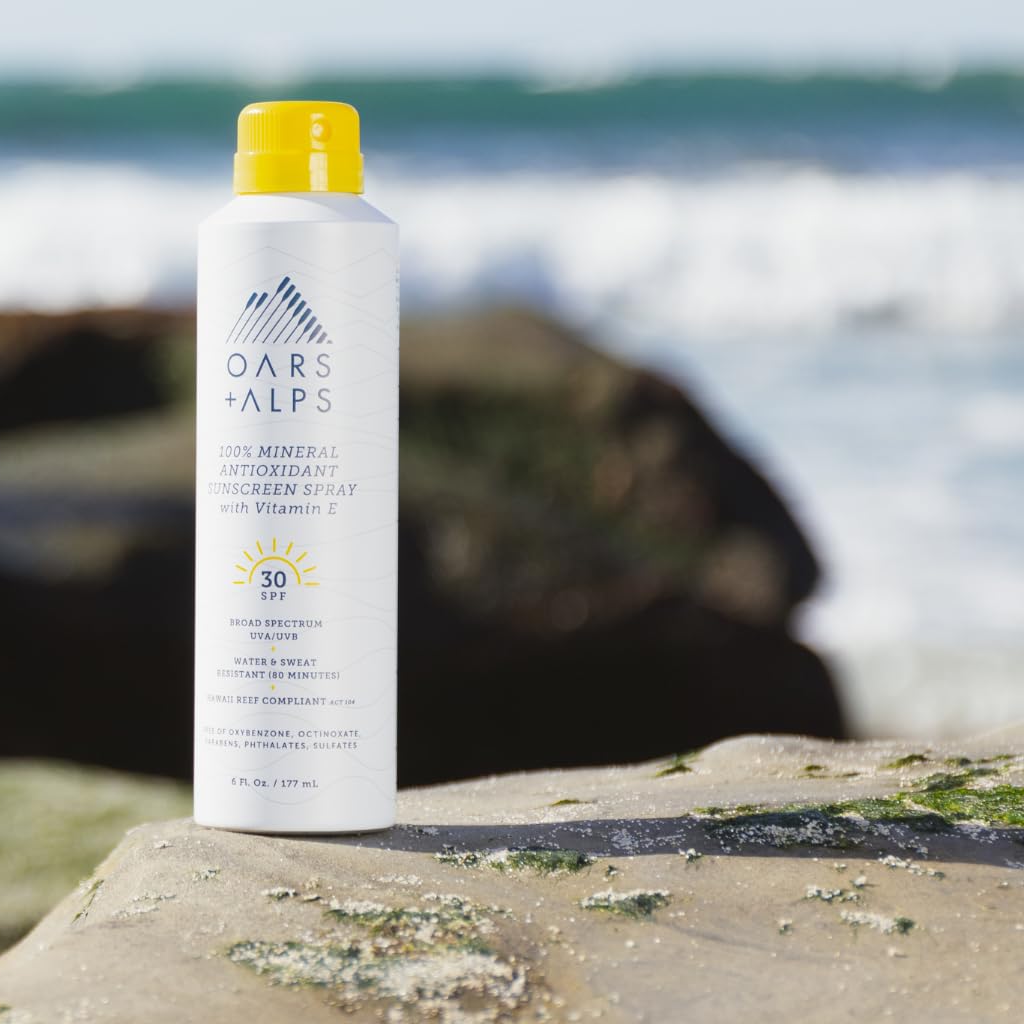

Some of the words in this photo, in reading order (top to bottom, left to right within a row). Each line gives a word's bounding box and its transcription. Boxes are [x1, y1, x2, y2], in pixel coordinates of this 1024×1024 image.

[227, 353, 330, 378] OARS
[219, 445, 253, 458] 100%
[257, 445, 339, 459] MINERAL
[219, 464, 339, 478] ANTIOXIDANT
[208, 482, 297, 496] SUNSCREEN
[303, 483, 357, 497] SPRAY
[220, 502, 249, 514] with
[255, 501, 321, 515] Vitamin
[328, 502, 338, 515] E
[261, 571, 287, 588] 30
[261, 591, 287, 601] SPF
[230, 618, 262, 627] BROAD
[264, 619, 323, 628] SPECTRUM
[250, 632, 298, 641] UVA/UVB
[234, 657, 267, 666] WATER
[270, 658, 277, 666] &
[280, 658, 317, 667] SWEAT
[268, 671, 284, 680] (80
[287, 671, 340, 680] MINUTES)
[236, 695, 259, 705] REEF
[262, 696, 327, 706] COMPLIANT
[228, 728, 294, 739] OXYBENZONE,
[244, 740, 309, 751] PHTHALATES,
[313, 742, 358, 750] SULFATES
[231, 778, 237, 786] 6
[253, 779, 270, 788] Oz.
[273, 779, 278, 788] /
[281, 779, 299, 788] 177
